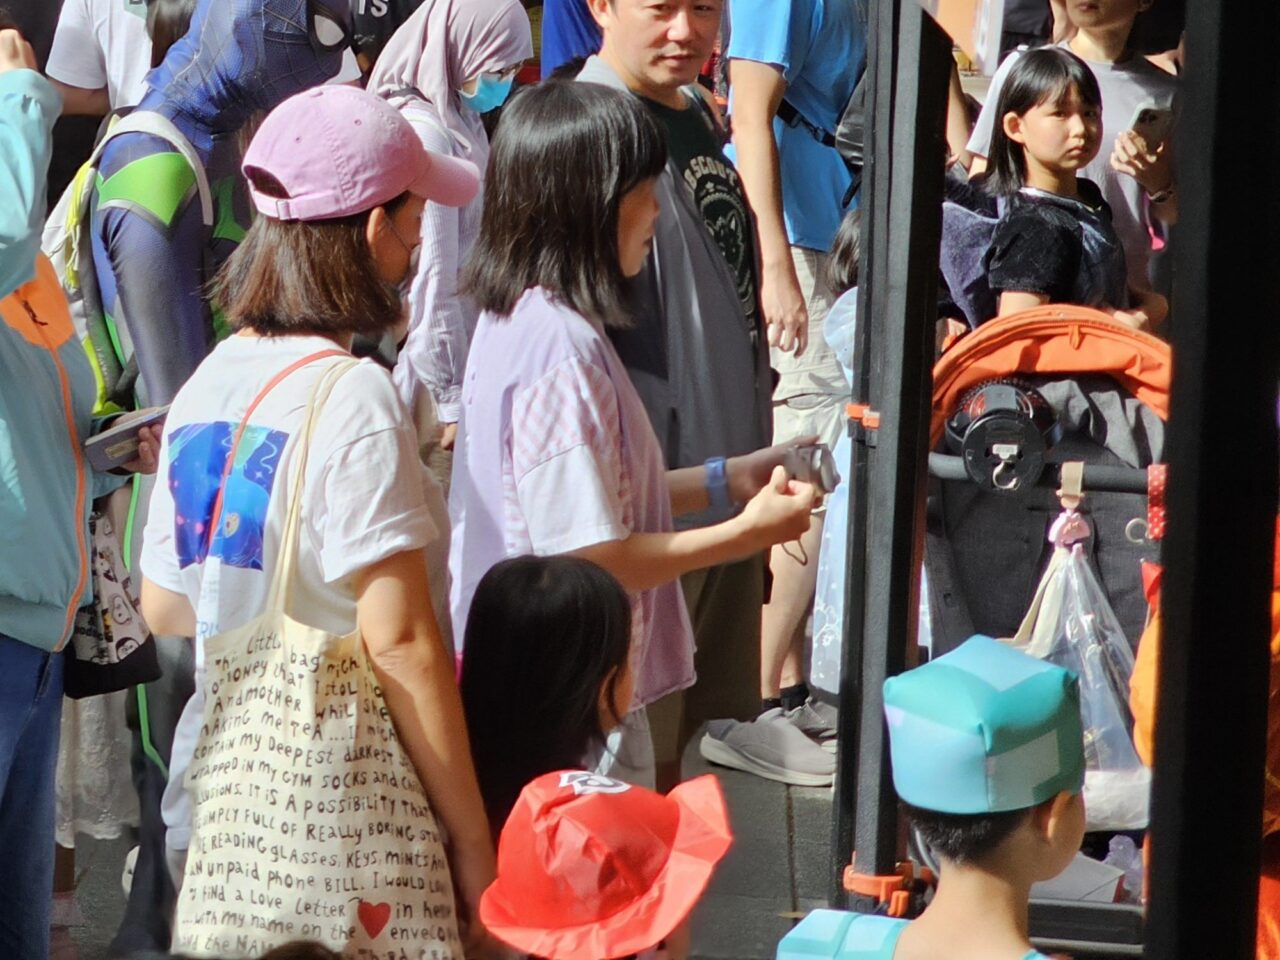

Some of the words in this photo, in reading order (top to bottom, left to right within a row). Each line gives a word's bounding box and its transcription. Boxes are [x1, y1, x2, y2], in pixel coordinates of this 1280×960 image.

[690, 155, 742, 197] SCOUT
[290, 645, 320, 674] bag
[261, 711, 282, 731] me
[240, 733, 261, 752] my
[258, 760, 277, 782] my
[321, 771, 367, 790] SOCKS
[373, 770, 399, 789] and
[285, 793, 297, 813] A
[245, 808, 275, 830] FULL
[280, 822, 297, 837] OF
[207, 860, 260, 884] unpaid
[267, 869, 315, 891] phone
[373, 871, 378, 889] I
[235, 889, 244, 902] a
[395, 902, 413, 920] in
[221, 910, 246, 928] my
[251, 913, 294, 936] name
[301, 922, 322, 937] on
[330, 925, 357, 940] the
